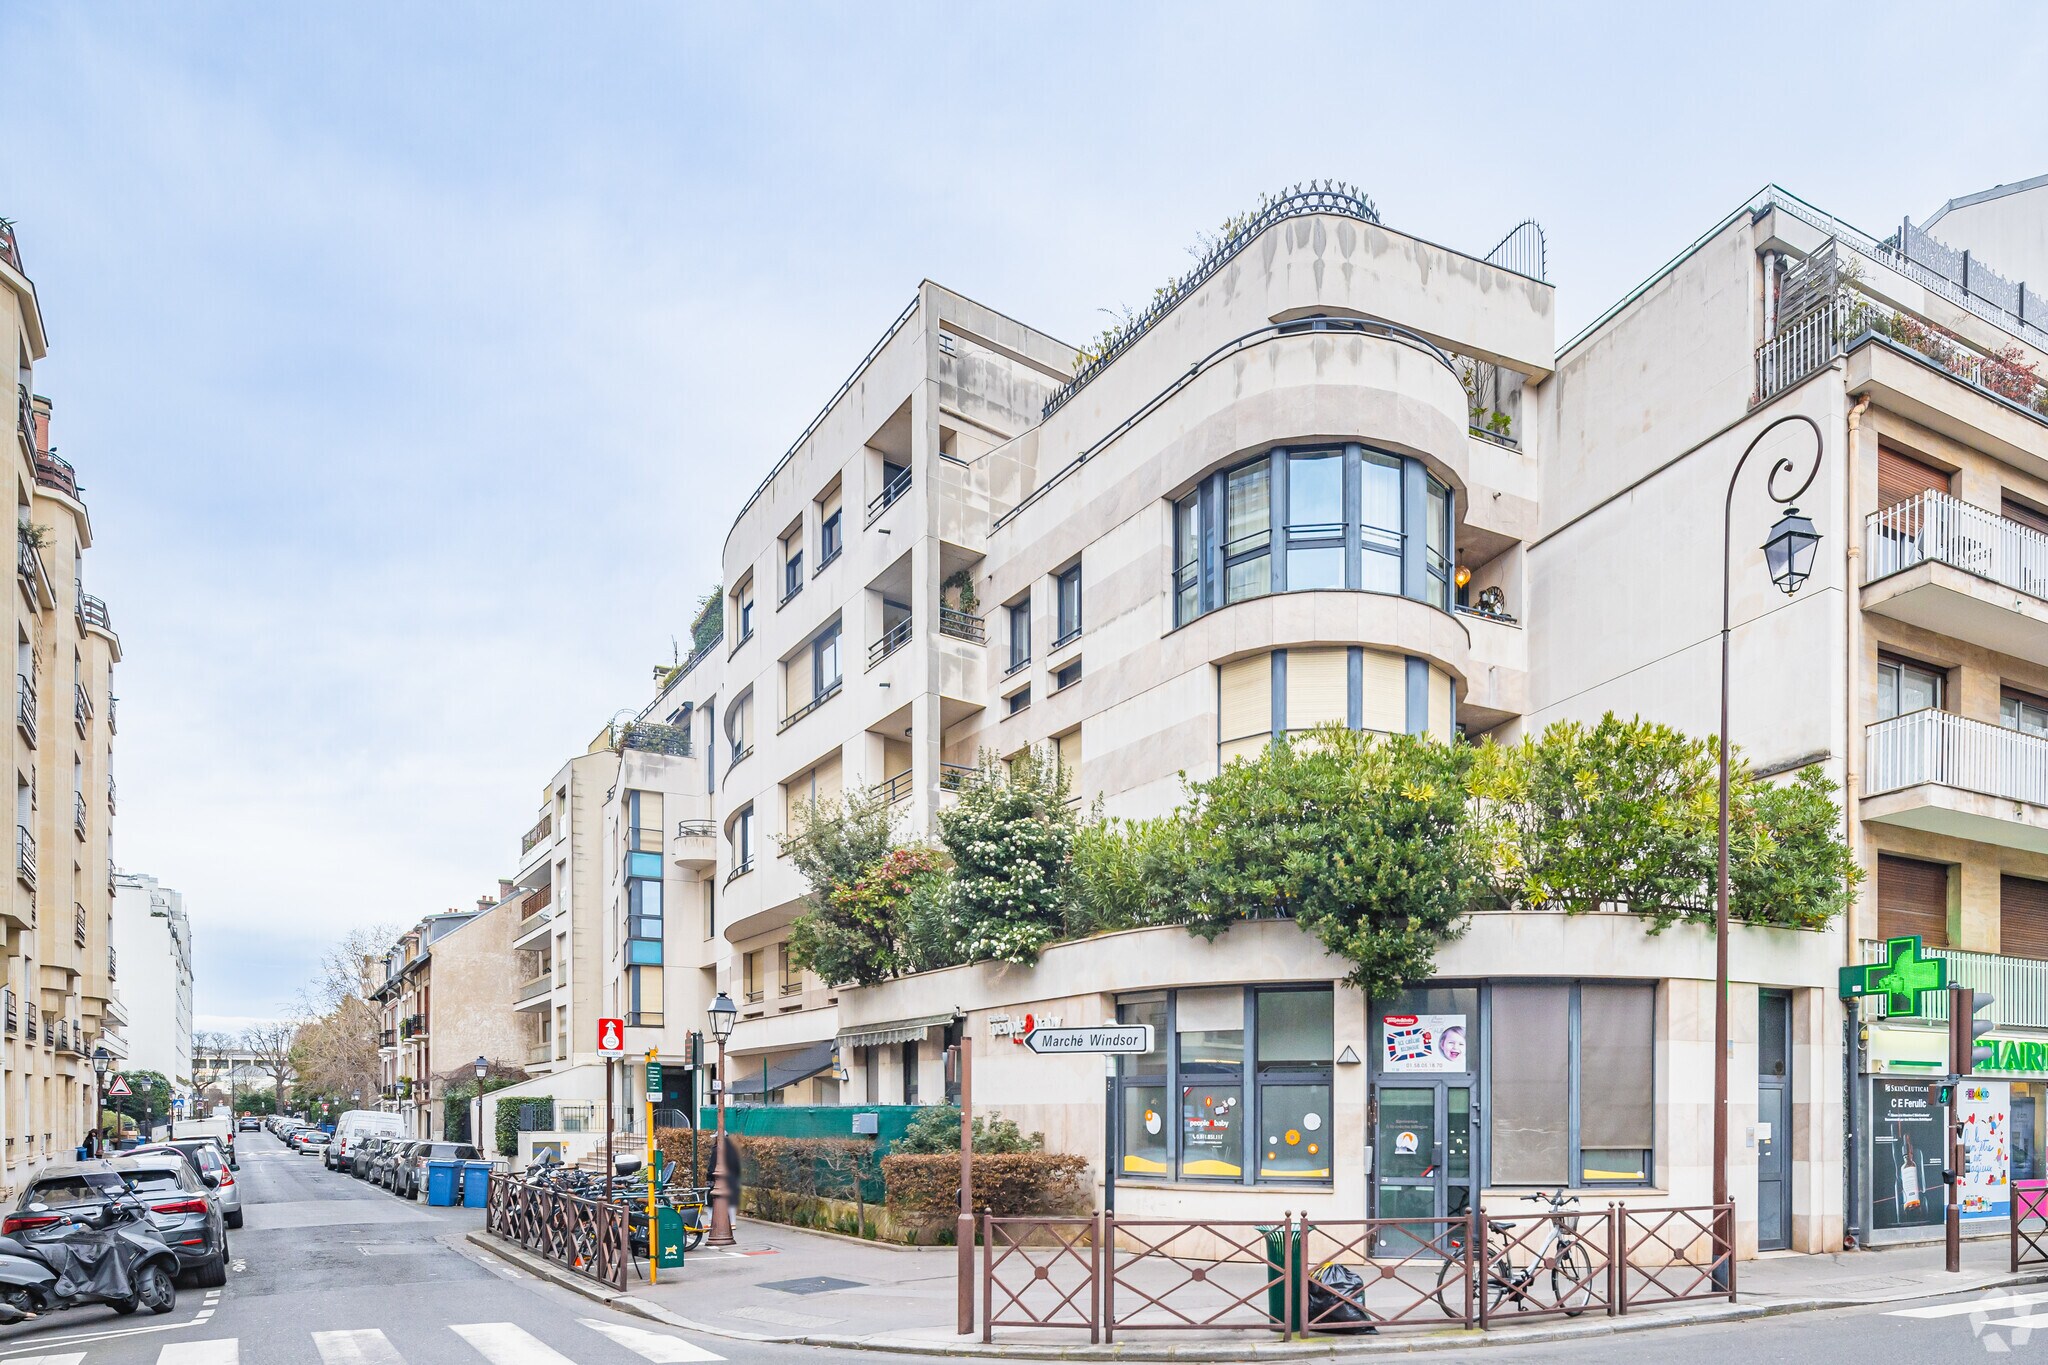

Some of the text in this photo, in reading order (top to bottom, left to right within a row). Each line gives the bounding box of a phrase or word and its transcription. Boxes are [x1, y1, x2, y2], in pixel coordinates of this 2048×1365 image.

[1042, 1034, 1139, 1047] Marché Windsor
[1891, 1099, 1927, 1108] C E Ferulic
